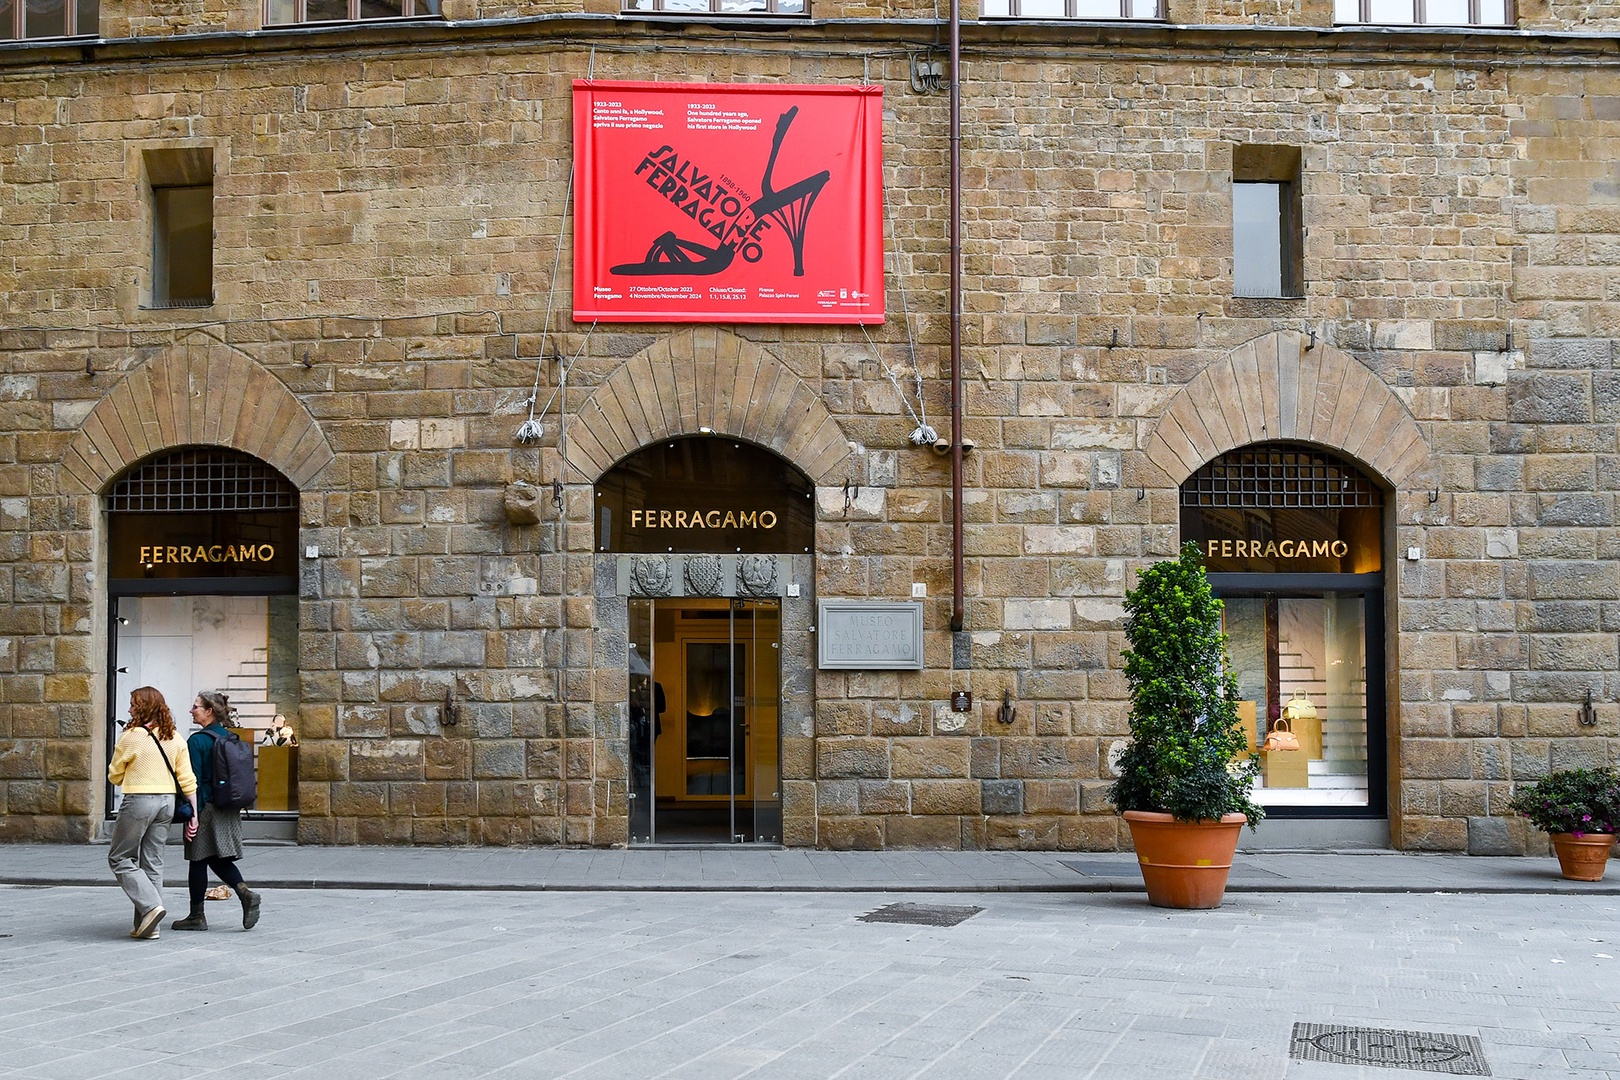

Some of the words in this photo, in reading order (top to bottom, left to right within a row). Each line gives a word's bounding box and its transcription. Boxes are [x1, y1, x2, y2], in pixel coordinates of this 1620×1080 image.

[648, 145, 772, 241] SALVATORE
[719, 174, 751, 202] 1898-1960
[634, 157, 763, 263] FERRAGAMO
[630, 510, 778, 528] FERRAGAMO
[140, 544, 275, 564] FERRAGAMO
[1207, 539, 1348, 558] FERRAGAMO
[850, 616, 893, 626] MUSEO
[834, 630, 906, 640] SALVATORE
[831, 644, 910, 654] FERRAGAMO
